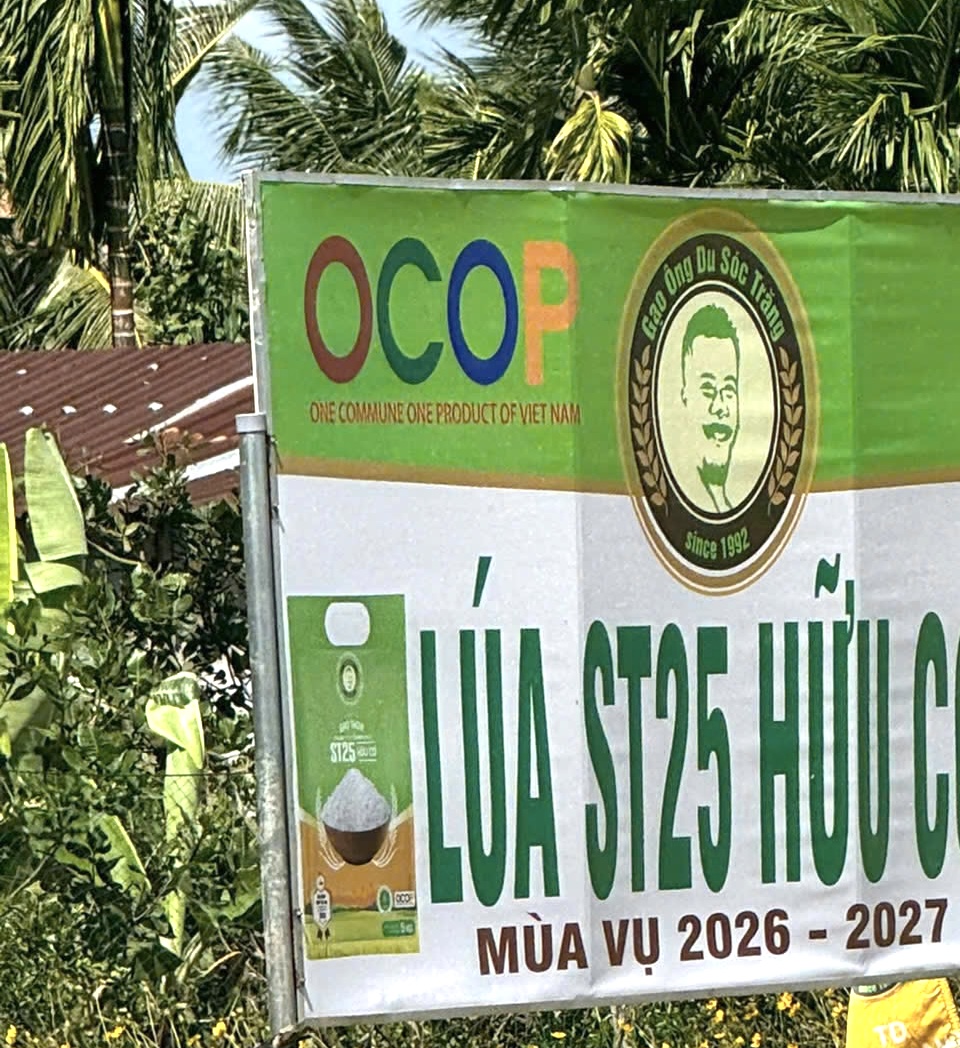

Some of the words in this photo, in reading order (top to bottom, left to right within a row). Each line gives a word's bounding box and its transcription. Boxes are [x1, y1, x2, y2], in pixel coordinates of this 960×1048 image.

[304, 235, 580, 386] OCOP
[642, 290, 667, 341] Gạo
[664, 256, 694, 296] Ông
[696, 245, 715, 273] Du
[720, 246, 749, 286] Sóc
[750, 269, 786, 342] Trăng
[310, 402, 336, 424] ONE
[338, 402, 404, 424] COMMUNE
[407, 402, 433, 424] ONE
[436, 402, 497, 424] PRODUCT
[500, 402, 520, 424] OF
[520, 402, 547, 424] VIET
[551, 402, 581, 425] NAM
[685, 530, 717, 560] since
[720, 526, 750, 559] 1992
[330, 741, 356, 763] ST25
[419, 555, 561, 907] LÚA
[583, 619, 733, 901] ST25
[758, 553, 890, 887] HỮU
[476, 911, 589, 975] MÙA
[601, 916, 661, 975] VỤ
[678, 908, 790, 960] 2026
[809, 928, 828, 940] -
[844, 898, 949, 950] 2027
